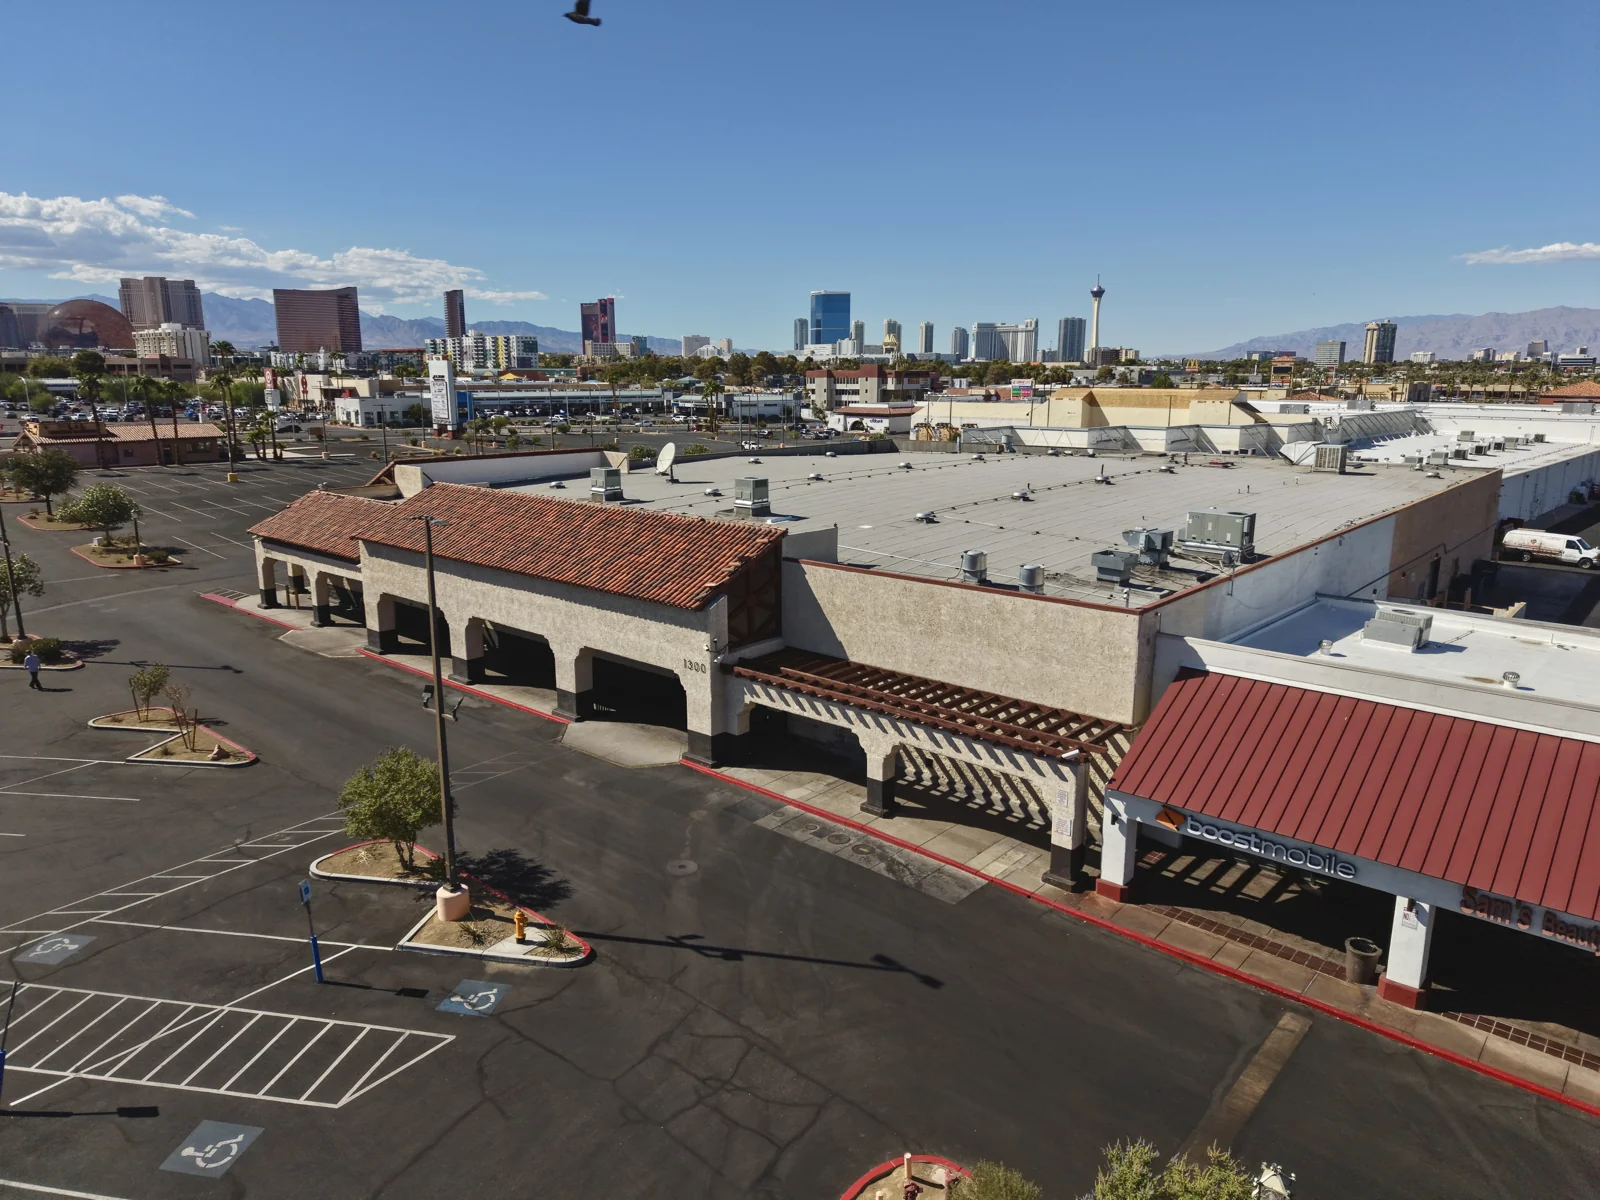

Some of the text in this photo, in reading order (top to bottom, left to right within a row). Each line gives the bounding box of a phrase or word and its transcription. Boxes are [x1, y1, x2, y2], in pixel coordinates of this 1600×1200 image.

[683, 658, 707, 674] 1300
[1187, 815, 1356, 879] boostmobile
[1460, 886, 1600, 957] Sam's Beaut
